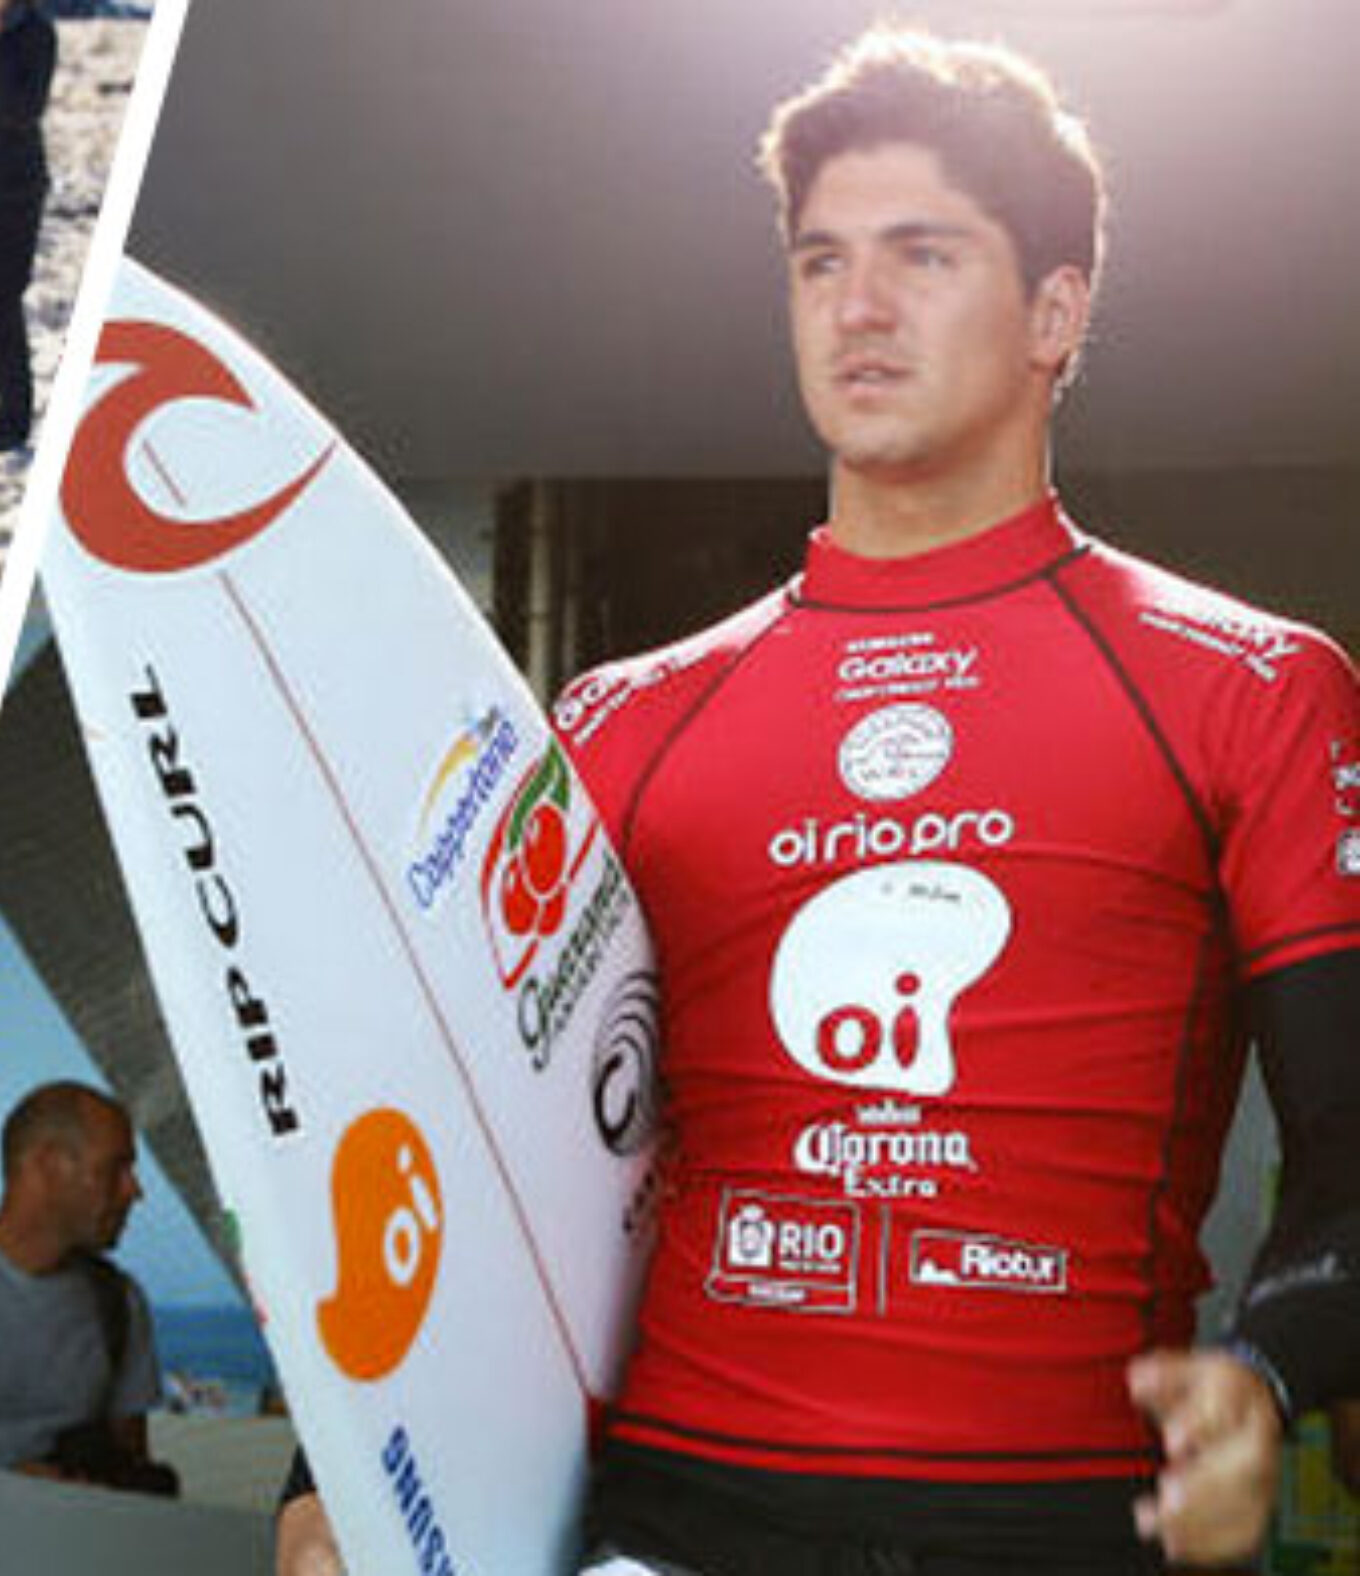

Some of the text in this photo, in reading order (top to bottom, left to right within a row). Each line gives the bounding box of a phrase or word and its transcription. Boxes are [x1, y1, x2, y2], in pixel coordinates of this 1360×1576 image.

[837, 645, 979, 682] Galaxy
[130, 663, 300, 1137] RIP CURL
[795, 1121, 980, 1178] Corona
[844, 1170, 938, 1198] Extra
[779, 1222, 846, 1261] RIO
